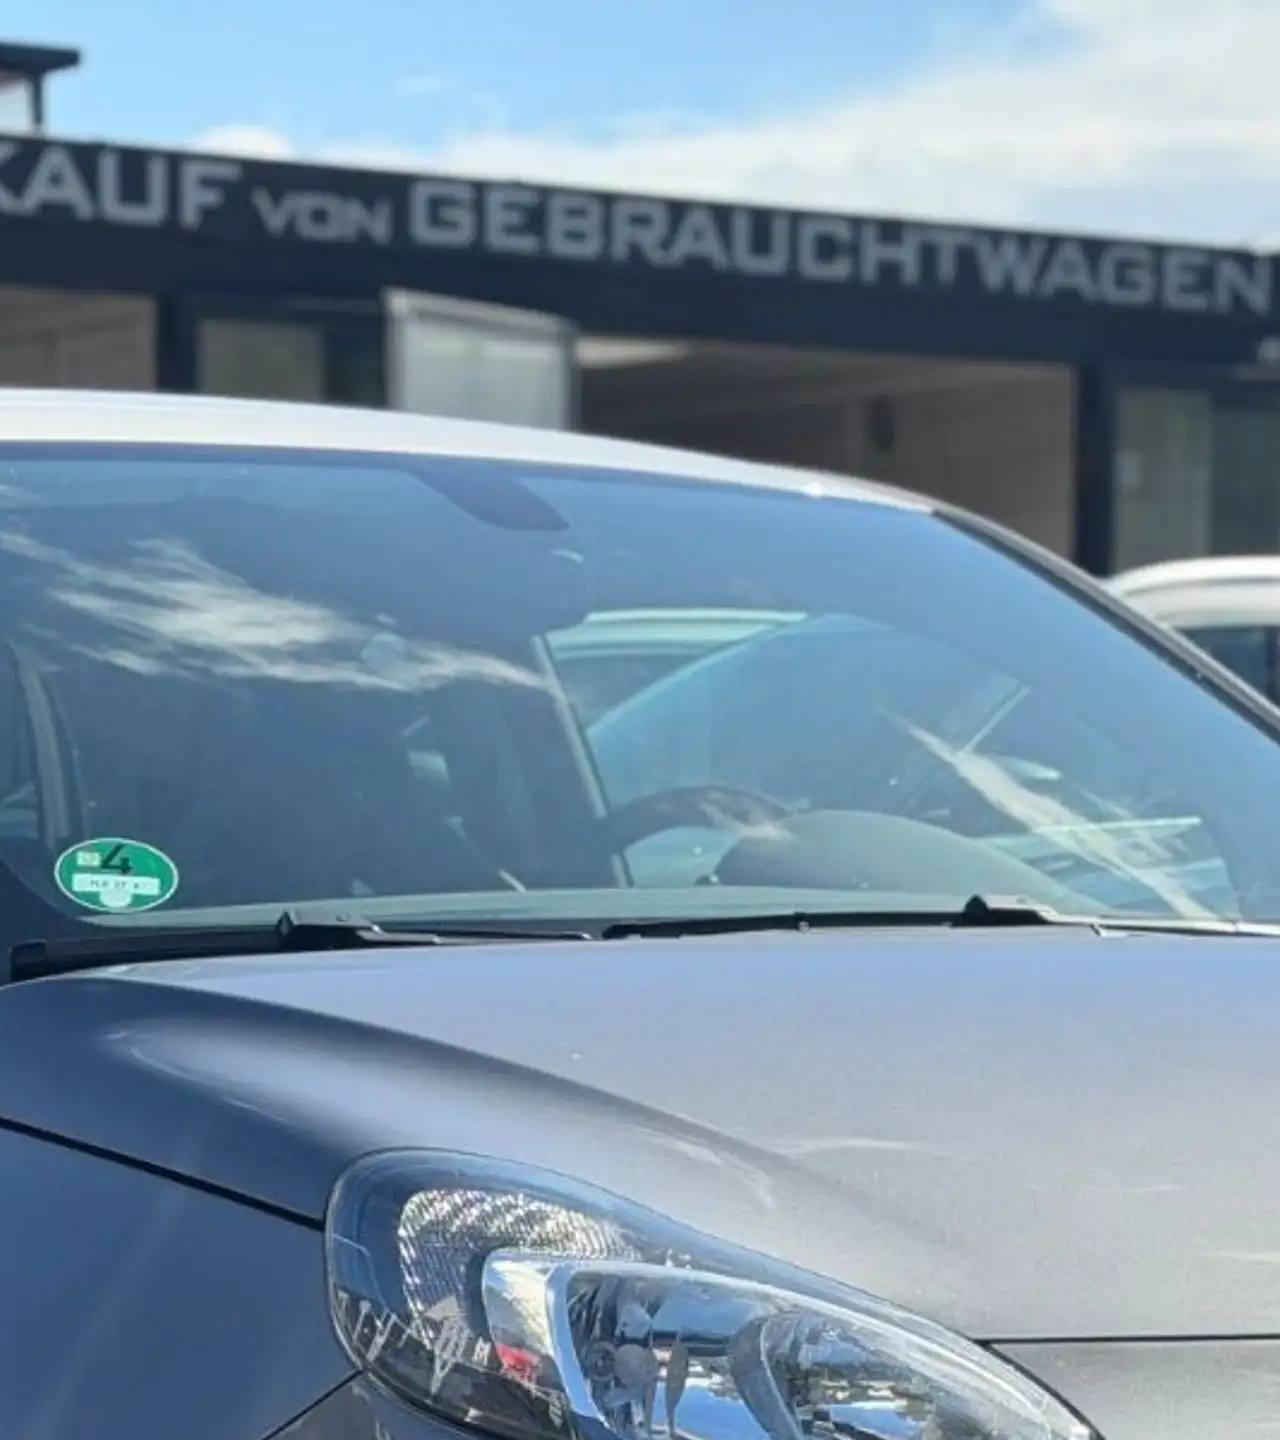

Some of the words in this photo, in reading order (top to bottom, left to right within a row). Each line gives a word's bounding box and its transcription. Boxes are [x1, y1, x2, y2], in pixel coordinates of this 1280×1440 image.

[251, 185, 391, 246] VON
[408, 180, 1272, 314] GEBRAUCHTWAGEN
[100, 843, 132, 874] 4
